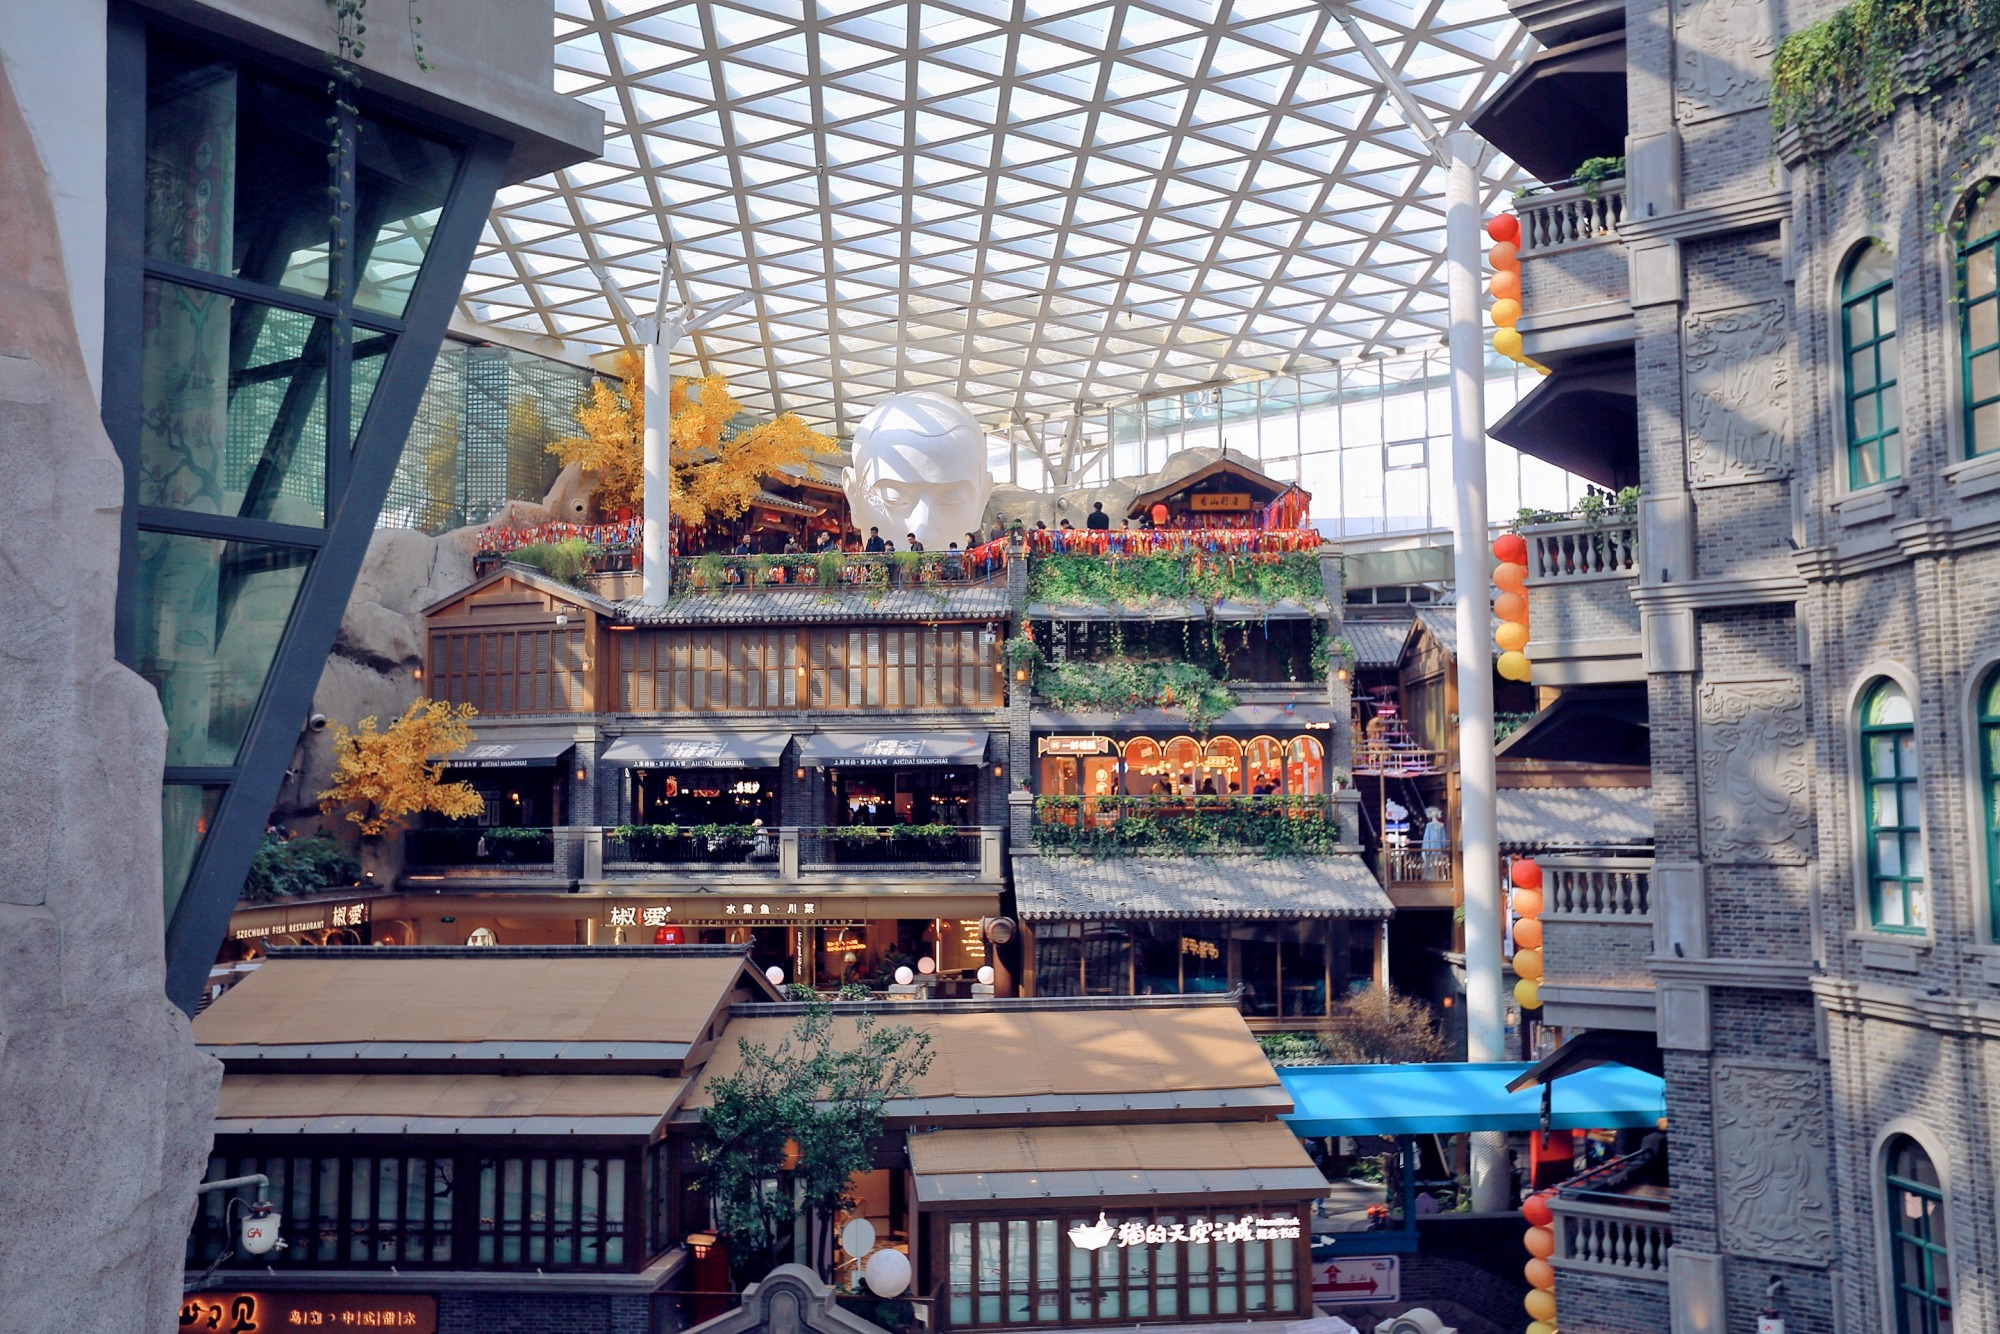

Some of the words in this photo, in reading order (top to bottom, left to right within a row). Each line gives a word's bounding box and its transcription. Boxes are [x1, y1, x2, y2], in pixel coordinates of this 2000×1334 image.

[236, 927, 270, 939] SZECHUAN
[272, 925, 286, 935] FISH
[288, 920, 325, 933] RESTAURANT
[1117, 1215, 1257, 1248] 猫的天空之城
